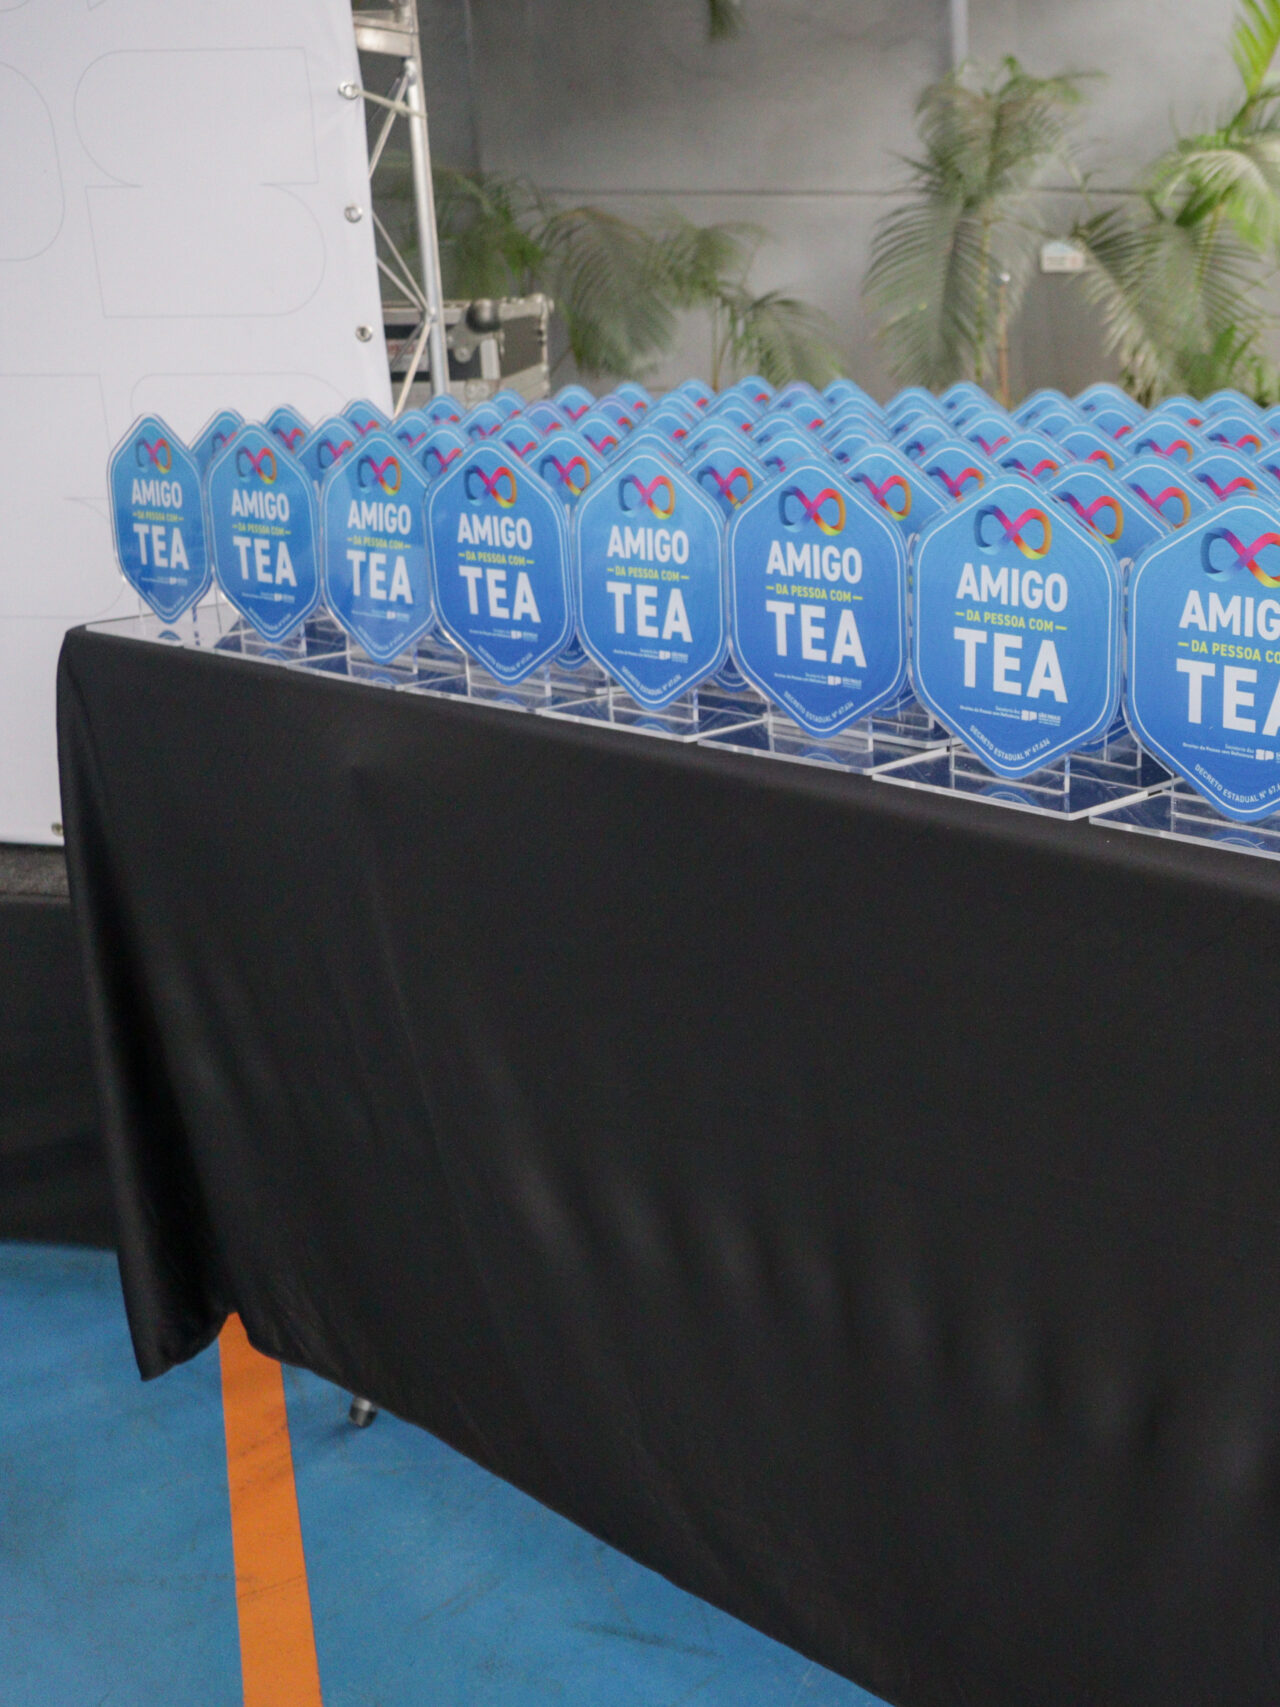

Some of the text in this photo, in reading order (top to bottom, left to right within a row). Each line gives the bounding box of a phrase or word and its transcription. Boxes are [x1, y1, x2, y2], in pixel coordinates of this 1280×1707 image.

[131, 479, 183, 509] AMIGO
[231, 489, 290, 522] AMIGO
[347, 500, 412, 535] AMIGO
[457, 513, 533, 550] AMIGO
[133, 523, 190, 570] TEA
[232, 535, 297, 587] TEA
[606, 524, 689, 565] AMIGO
[766, 540, 863, 584] AMIGO
[346, 549, 414, 604] TEA
[458, 565, 541, 623] TEA
[615, 566, 680, 581] DA PESSOA COM
[776, 583, 852, 602] DA PESSOA COM
[956, 562, 1068, 613] AMIGO
[606, 581, 693, 643] TEA
[966, 609, 1054, 632] DA PESSOA COM
[765, 599, 867, 668] TEA
[1191, 639, 1209, 654] DA
[1212, 642, 1262, 662] PESSOA
[953, 626, 1068, 703] TEA
